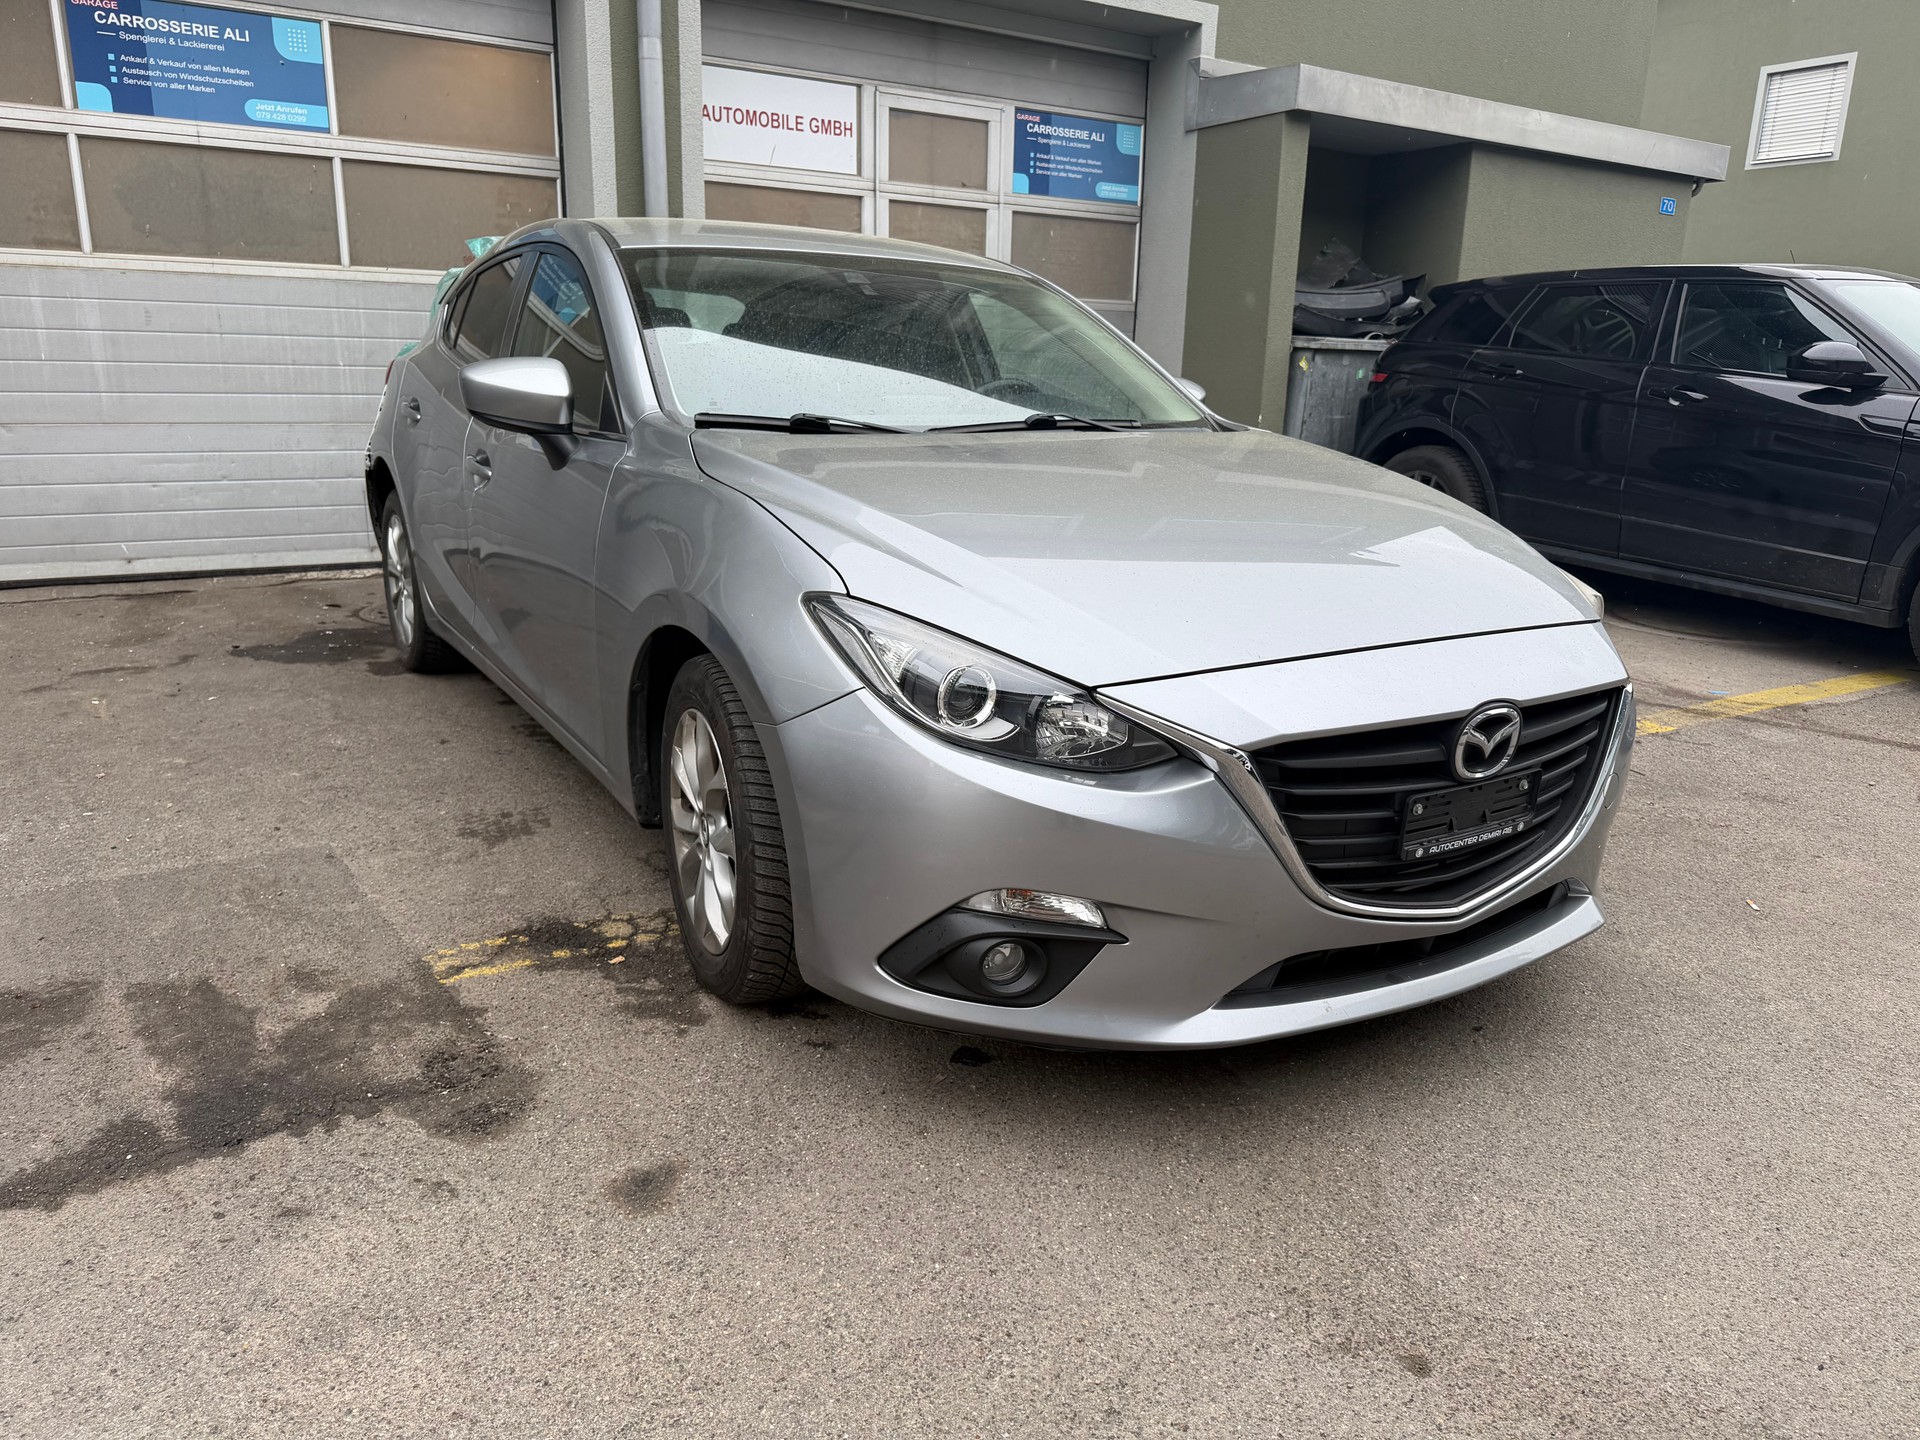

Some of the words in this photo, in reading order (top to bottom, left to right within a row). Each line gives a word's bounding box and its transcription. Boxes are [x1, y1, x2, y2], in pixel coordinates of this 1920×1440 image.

[71, 0, 118, 9] GARAGE
[94, 11, 220, 38] CARROSSERIE
[224, 28, 249, 42] ALI
[119, 31, 166, 44] Spenglerei
[178, 39, 225, 51] Lackiererei
[120, 55, 147, 64] Ankauf
[157, 59, 186, 68] Verkauf
[222, 66, 250, 75] Marken
[122, 67, 161, 76] Austausch
[179, 73, 254, 87] Windschutzscheiben
[123, 77, 152, 86] Service
[188, 84, 215, 93] Marken
[256, 103, 275, 111] Jetzt
[276, 105, 307, 114] Anrufen
[1017, 114, 1040, 122] GARAGE
[702, 104, 804, 132] AUTOMOBILE
[809, 118, 853, 137] GMBH
[1027, 123, 1089, 140] CARROSSERIE
[1090, 132, 1104, 142] ALI
[1663, 200, 1673, 212] 70
[1429, 836, 1478, 853] AUTOCENTER
[1479, 830, 1501, 841] DEMIRI
[1502, 827, 1512, 835] AG
